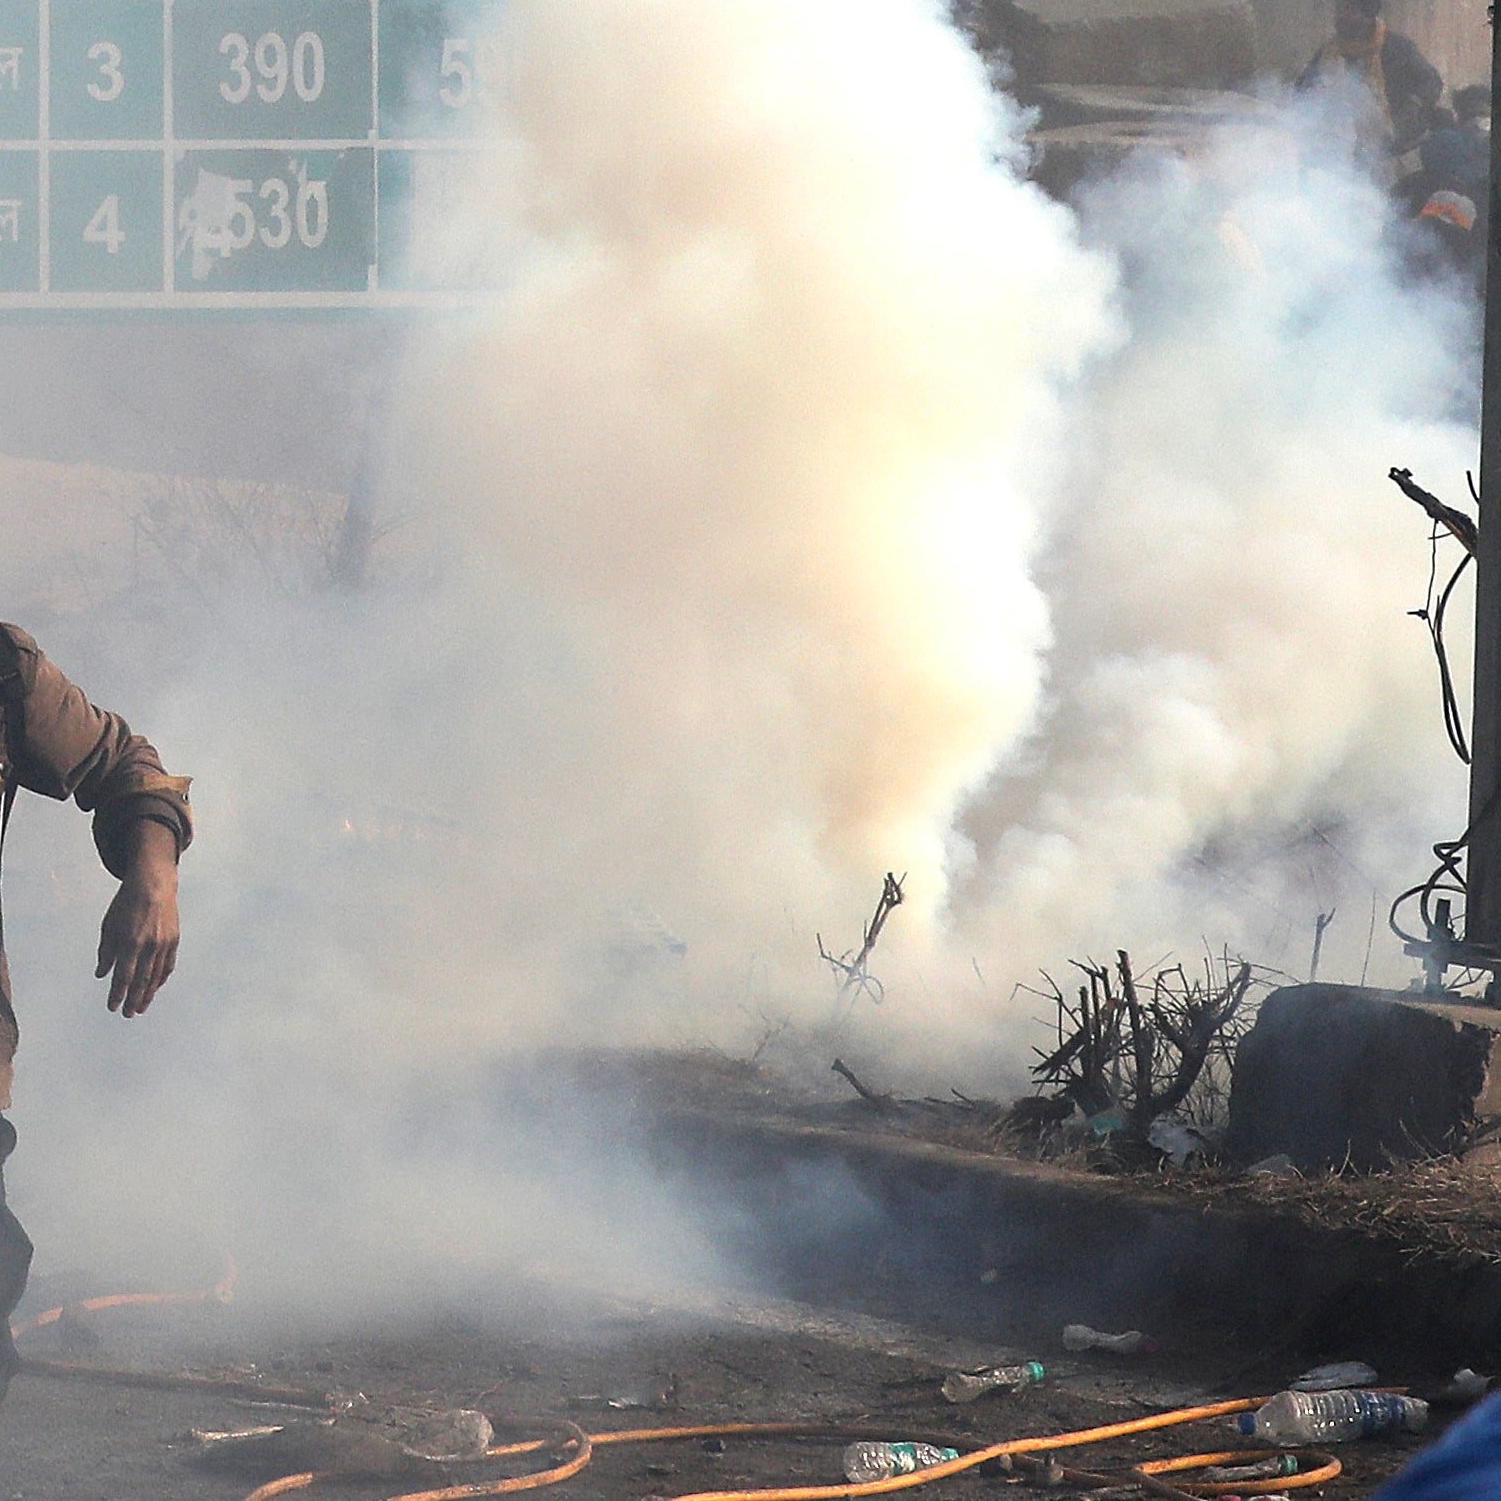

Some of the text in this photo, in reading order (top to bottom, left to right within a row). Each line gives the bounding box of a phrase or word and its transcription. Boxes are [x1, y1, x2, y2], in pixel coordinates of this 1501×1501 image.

[87, 43, 123, 101] 3
[218, 31, 326, 103] 390
[83, 195, 126, 254] 4
